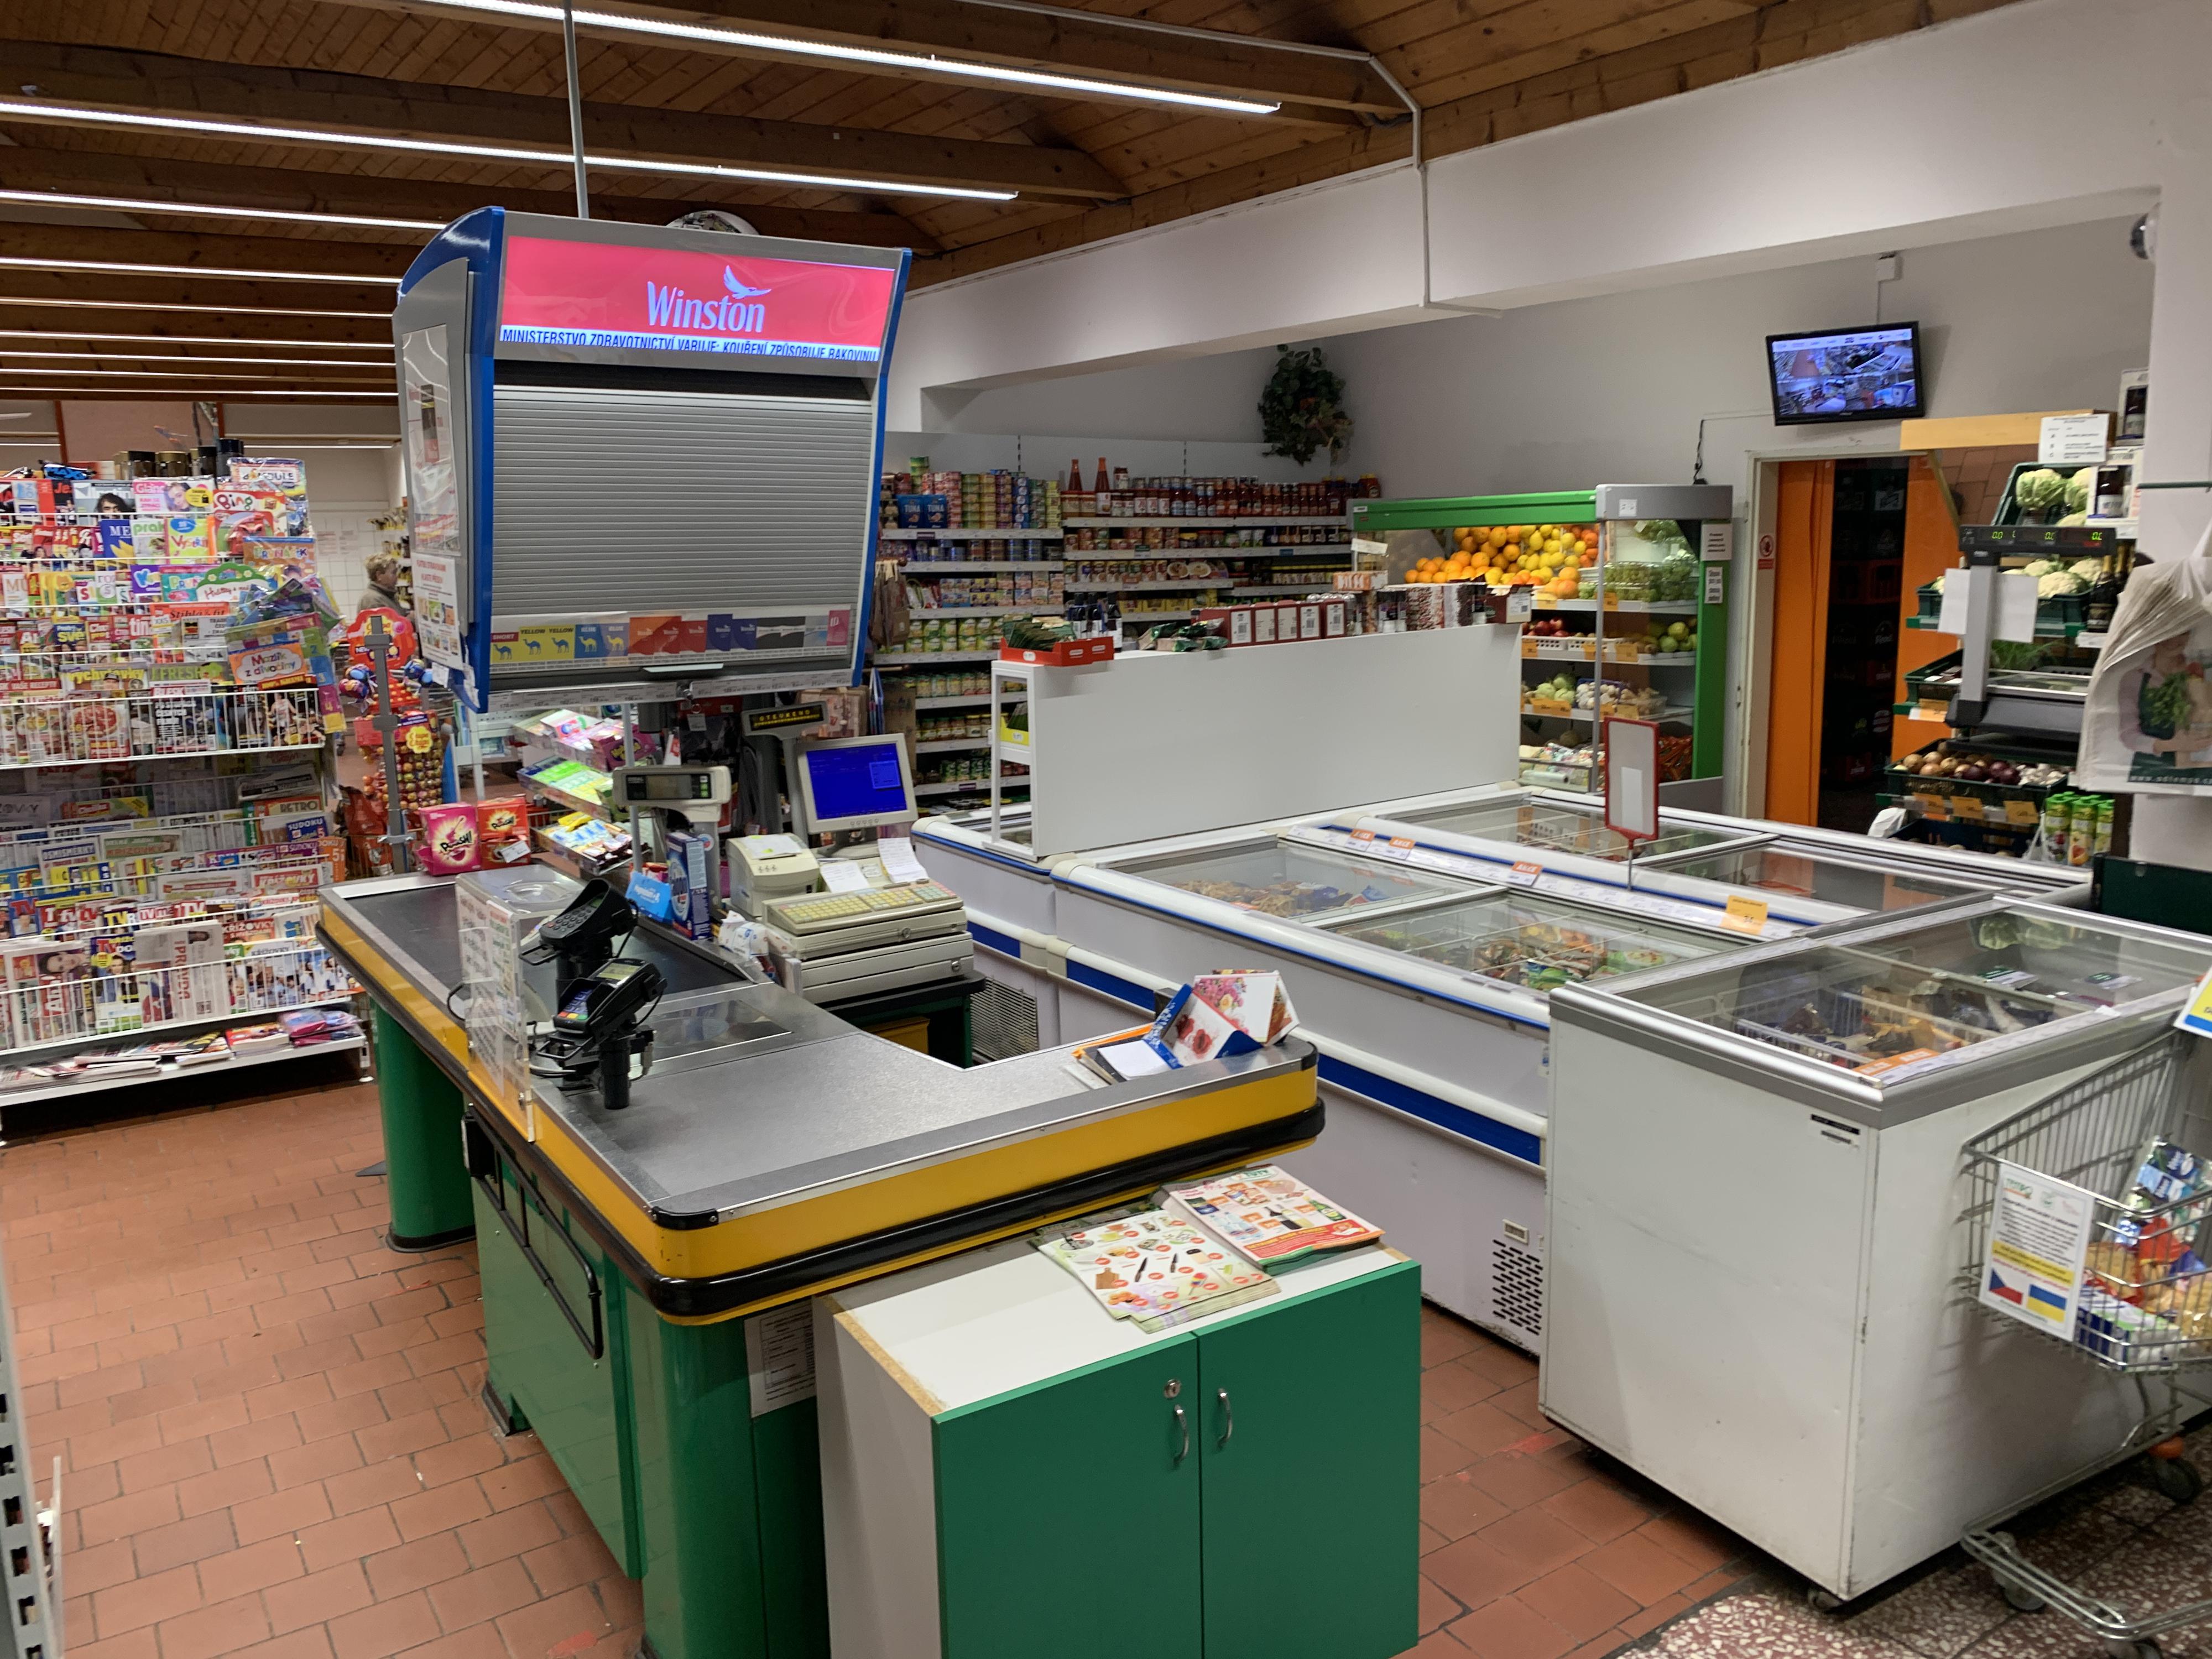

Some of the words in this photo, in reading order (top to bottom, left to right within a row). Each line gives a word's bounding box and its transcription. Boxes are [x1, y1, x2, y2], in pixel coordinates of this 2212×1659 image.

[647, 280, 765, 332] Winston
[503, 329, 586, 346] MINISTERSTVO
[590, 333, 675, 349] ZDRAVOTNICTVÍ
[723, 340, 769, 355] KOUŘENÍ
[280, 801, 318, 813] RETRO
[288, 817, 324, 830] SUDOKU
[289, 842, 318, 851] SUDOKU
